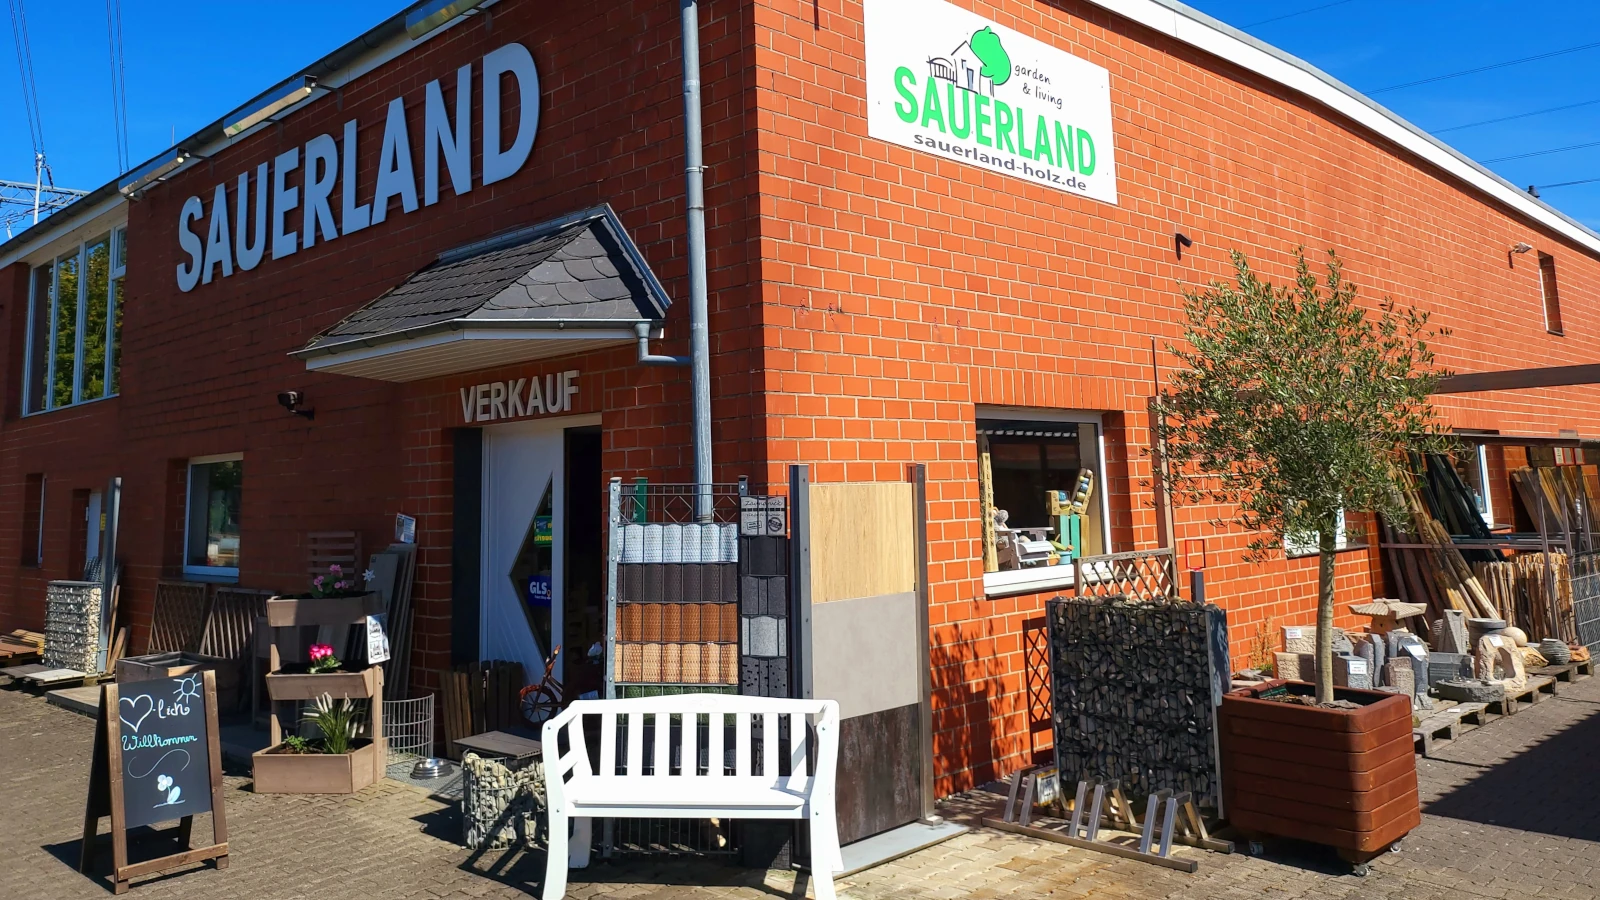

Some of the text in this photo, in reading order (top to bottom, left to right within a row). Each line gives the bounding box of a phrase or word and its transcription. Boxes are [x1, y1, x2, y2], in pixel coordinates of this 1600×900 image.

[1014, 65, 1051, 85] garden
[1022, 83, 1063, 110] & living
[894, 65, 1096, 176] SAUERLAND
[176, 42, 541, 293] SAUERLAND
[914, 132, 1087, 191] sauerland-holz.de
[459, 369, 580, 424] VERKAUF
[529, 581, 548, 595] GLS
[122, 734, 198, 751] Willkommen
